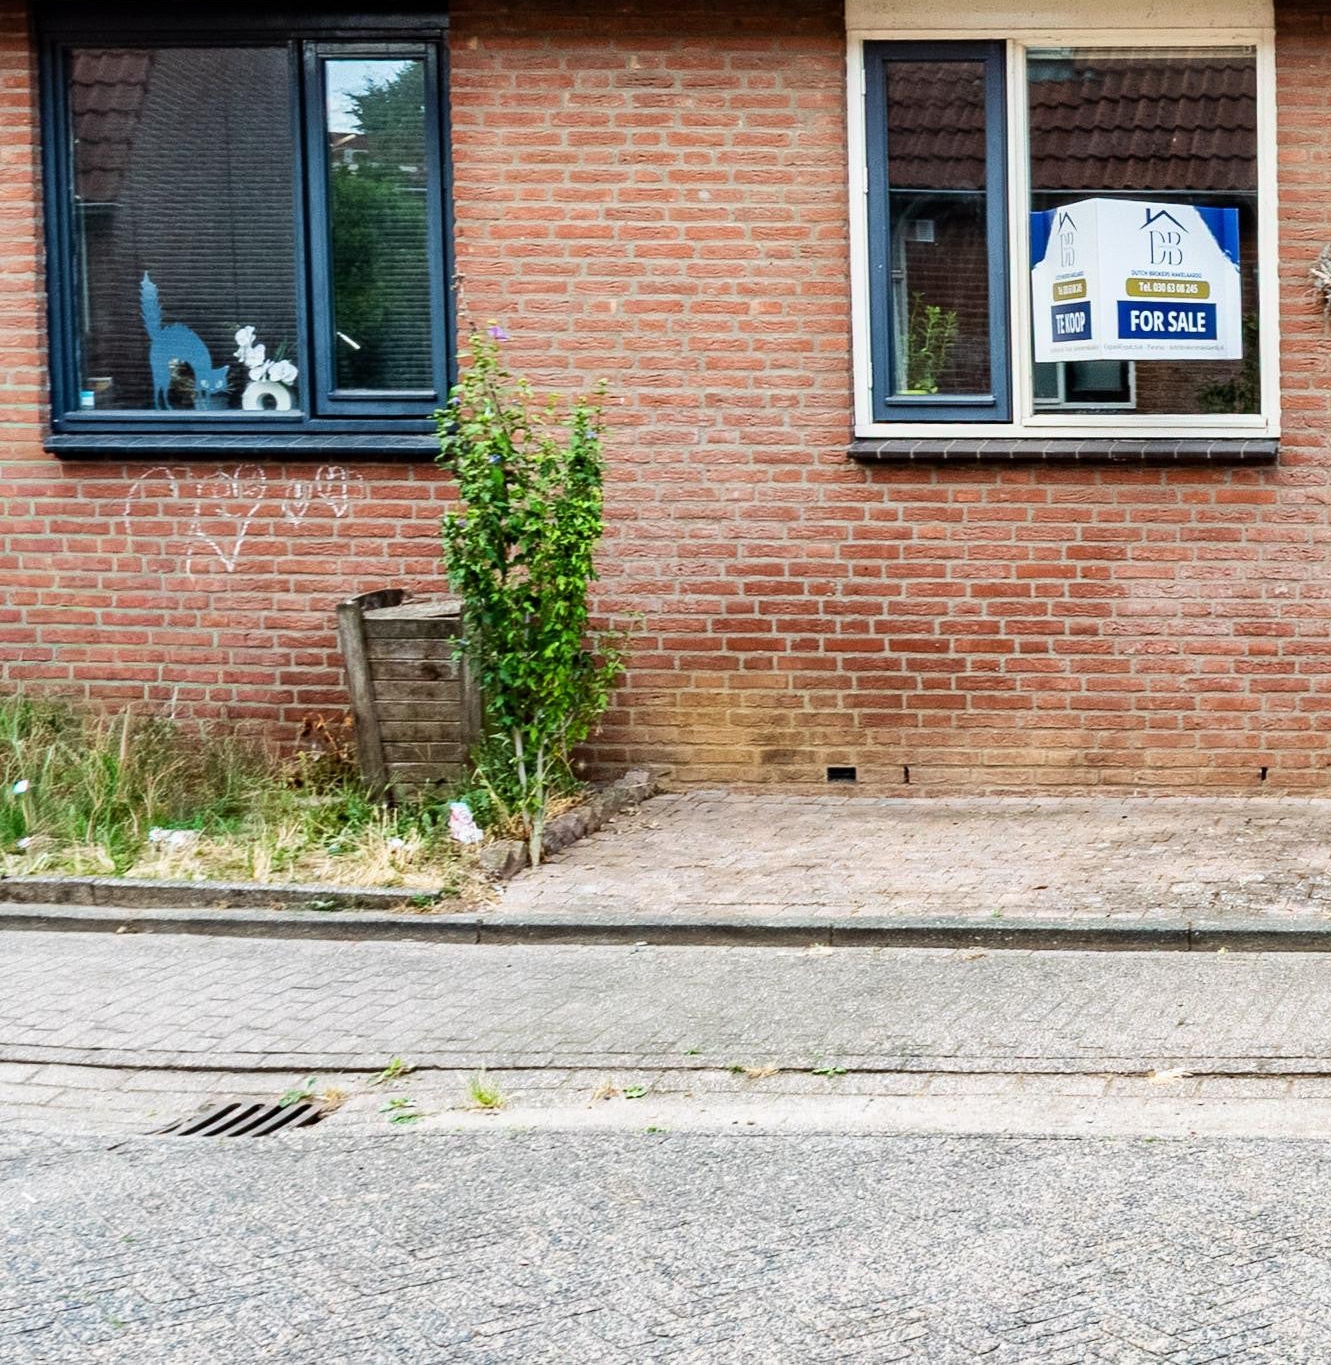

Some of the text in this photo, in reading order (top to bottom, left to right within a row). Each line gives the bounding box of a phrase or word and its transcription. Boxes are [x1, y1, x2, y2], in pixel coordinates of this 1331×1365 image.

[1150, 231, 1182, 266] DB
[1138, 282, 1152, 292] Tel.
[1153, 282, 1166, 292] 030
[1167, 283, 1175, 293] 63
[1186, 284, 1198, 294] 245
[1055, 311, 1086, 334] TE KOOP
[1130, 310, 1206, 332] FOR SALE
